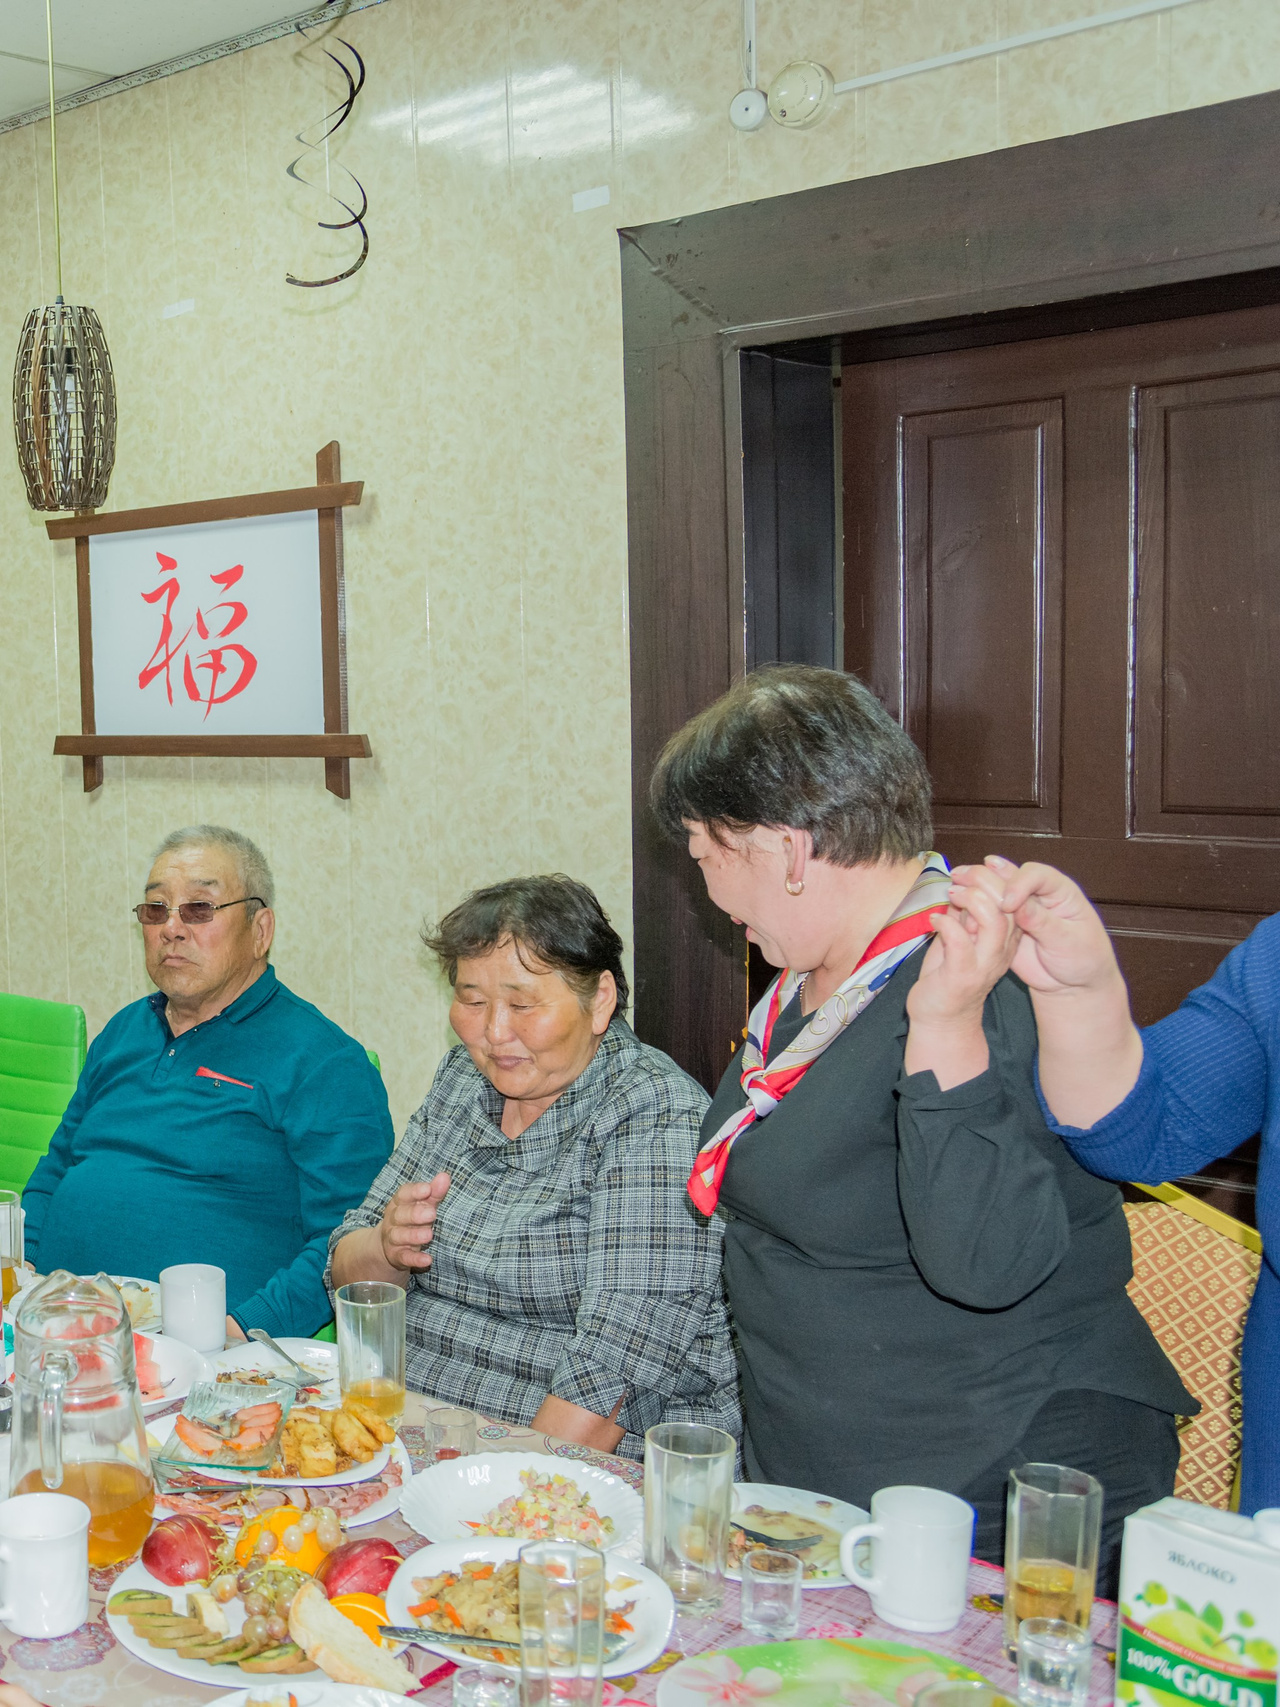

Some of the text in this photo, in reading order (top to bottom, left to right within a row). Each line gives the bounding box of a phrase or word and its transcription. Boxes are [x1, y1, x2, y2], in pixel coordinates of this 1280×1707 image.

[138, 551, 258, 723] 福
[1168, 1551, 1235, 1584] ЯБЛОКО
[1126, 1647, 1173, 1680] 100%
[1172, 1664, 1263, 1707] GOLD
